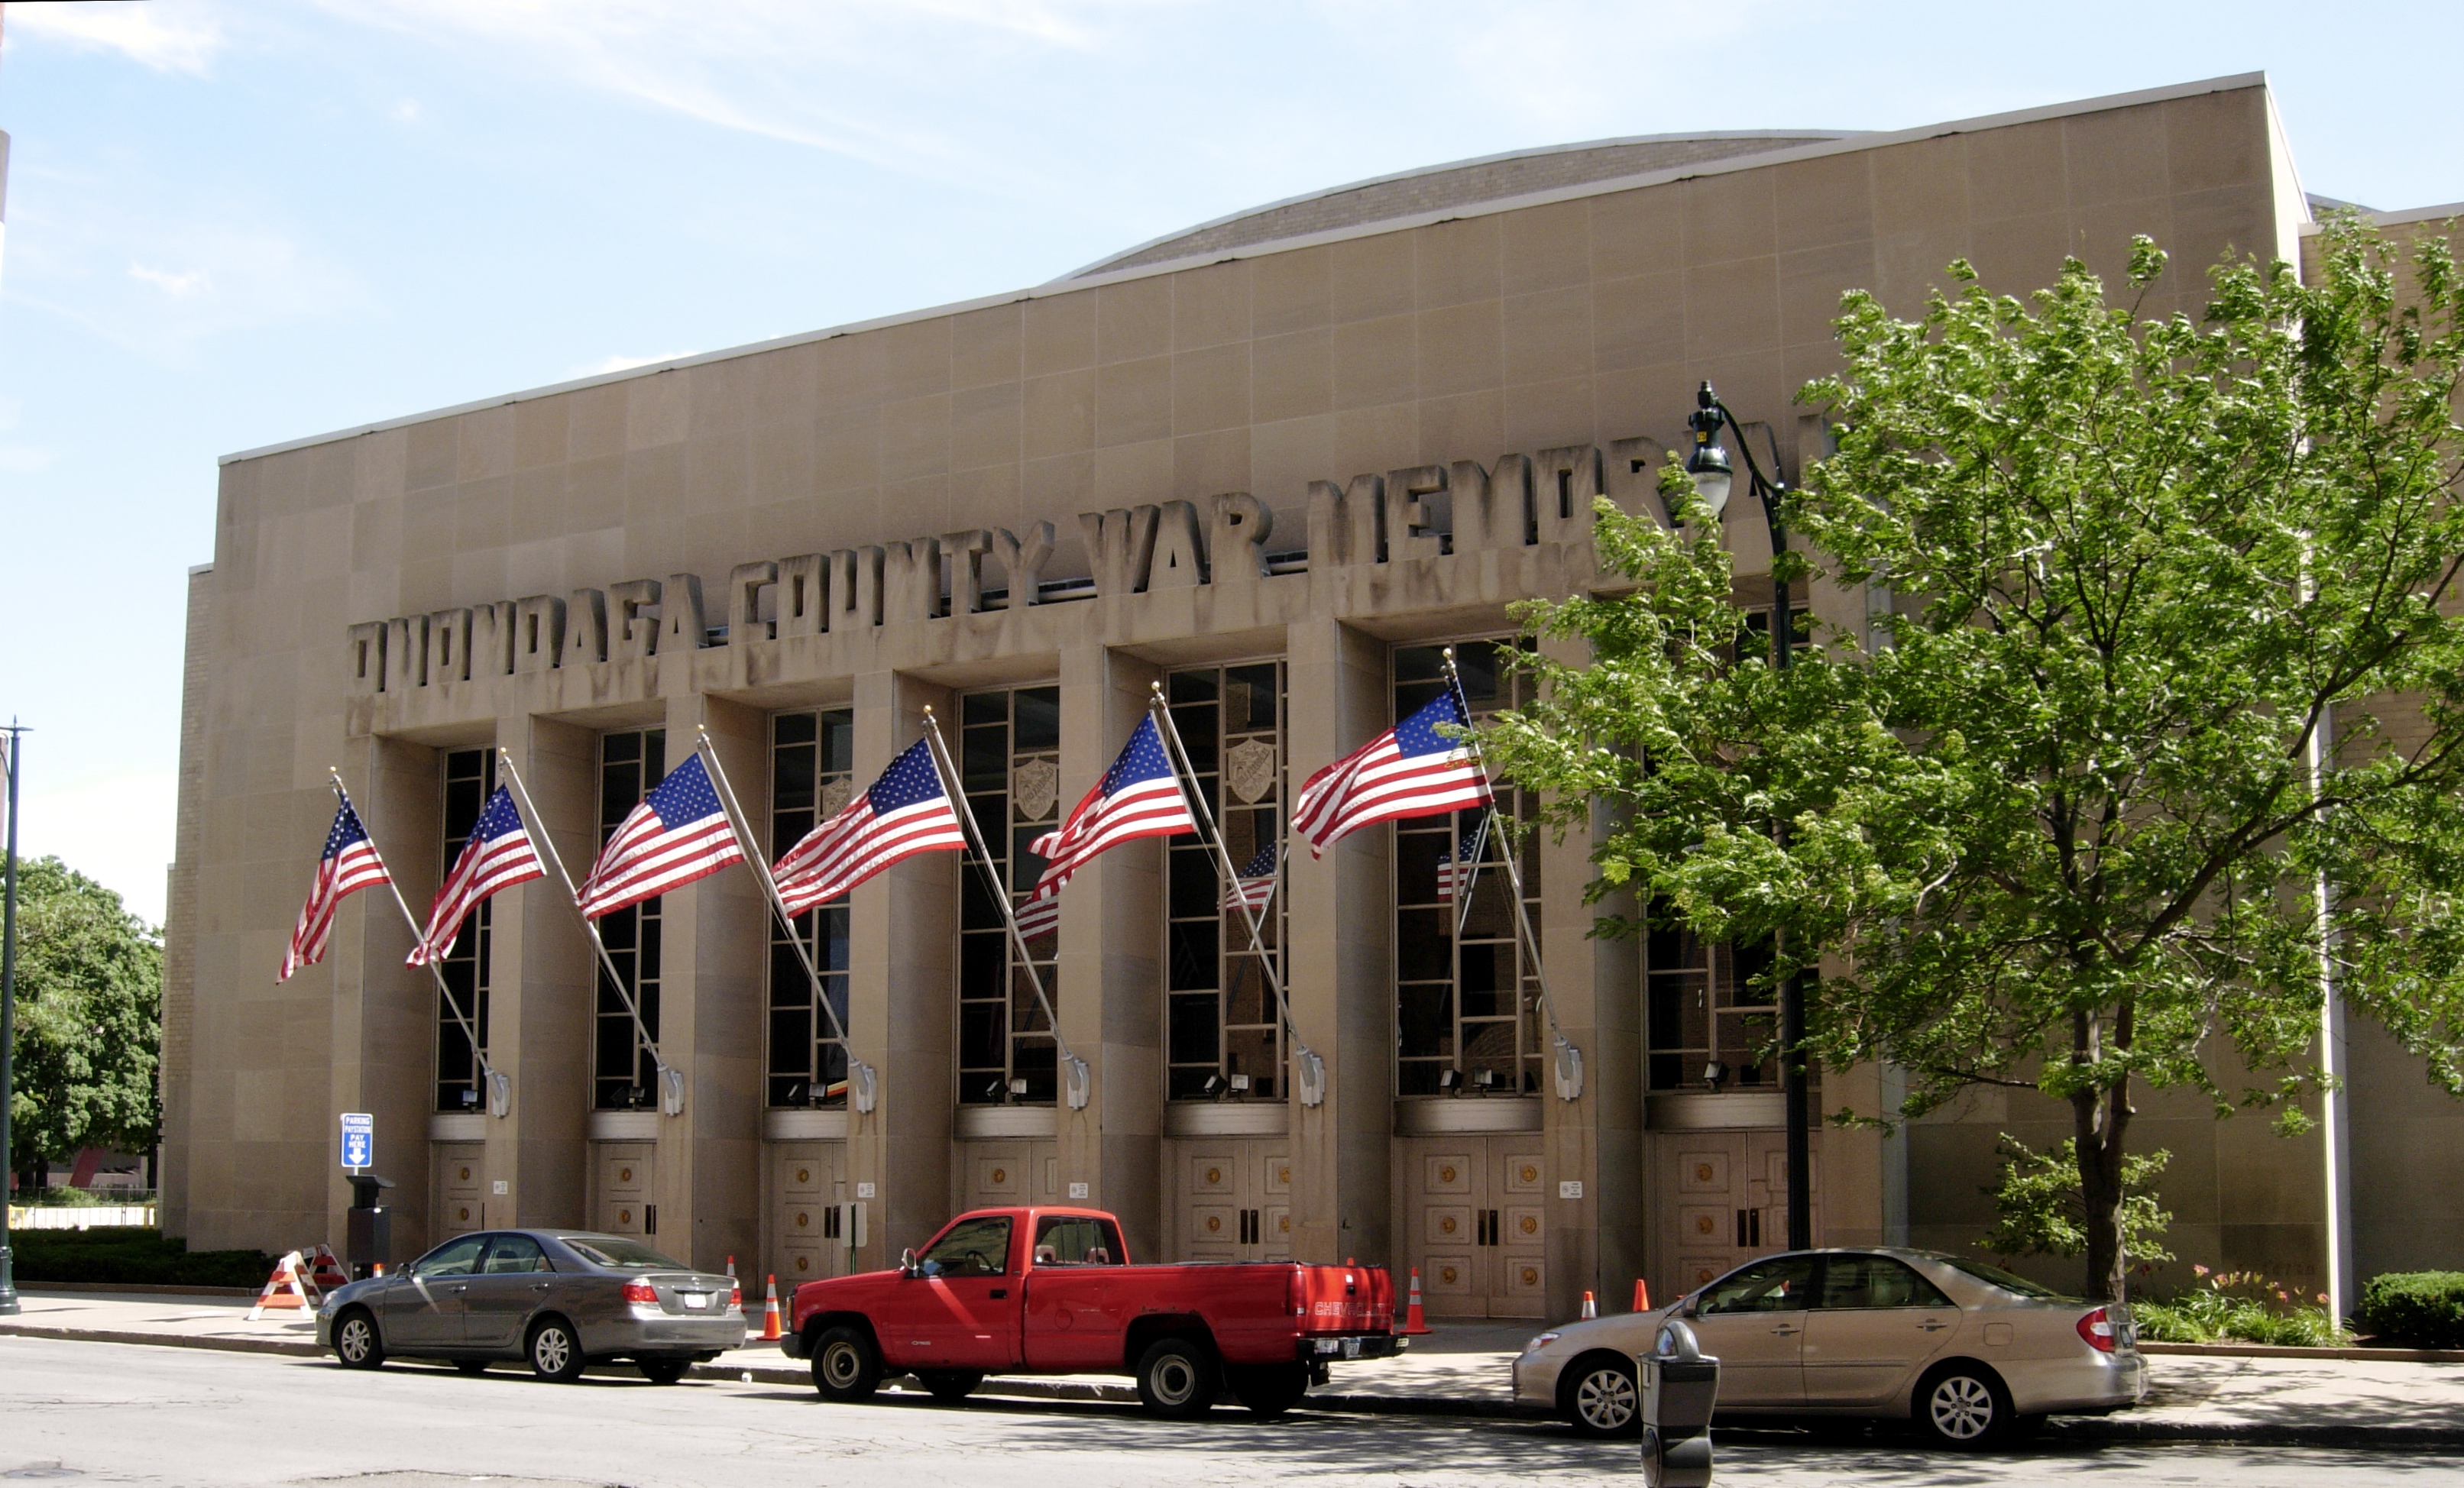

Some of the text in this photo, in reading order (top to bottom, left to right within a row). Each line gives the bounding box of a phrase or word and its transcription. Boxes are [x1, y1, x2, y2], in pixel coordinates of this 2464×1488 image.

[348, 412, 1838, 692] ONONDAGA COUNTY WAR MEMORA
[1315, 1301, 1387, 1316] CHEVROT
